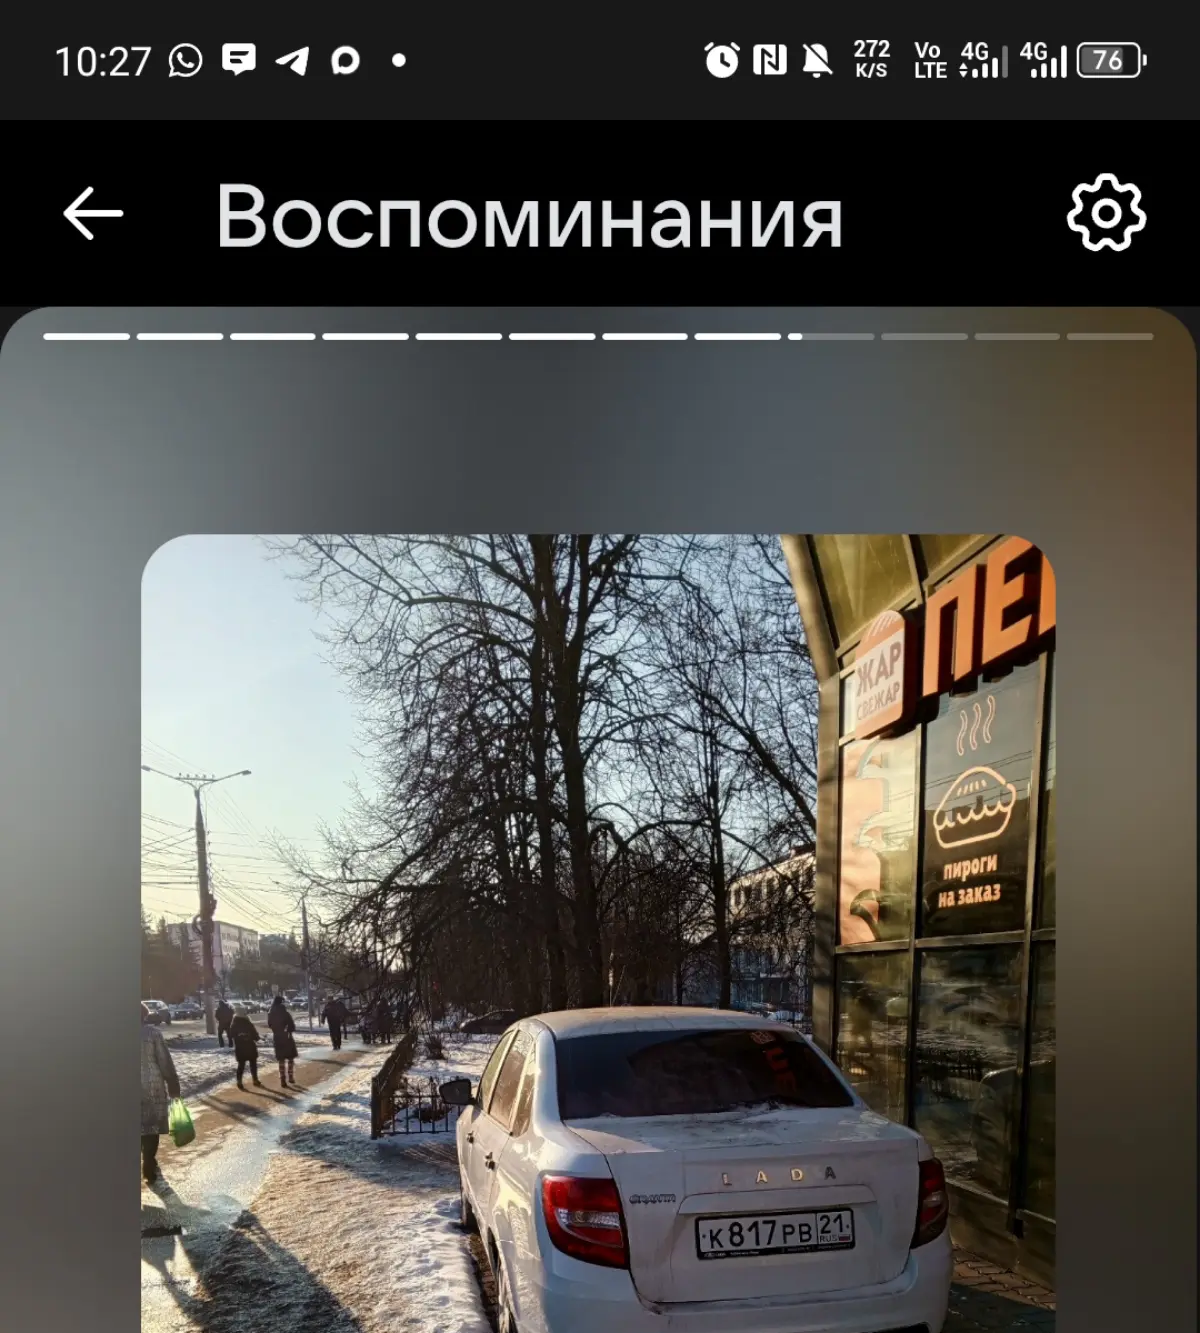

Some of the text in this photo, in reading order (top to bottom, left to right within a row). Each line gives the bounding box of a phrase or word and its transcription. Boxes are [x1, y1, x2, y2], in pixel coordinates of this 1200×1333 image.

[856, 641, 902, 697] ЖАР
[856, 681, 901, 721] СВЕЖАР
[943, 854, 998, 882] пироги
[938, 883, 1002, 908] на заказ
[721, 1166, 837, 1186] LADA
[819, 1213, 845, 1234] 21
[819, 1234, 838, 1242] RUS
